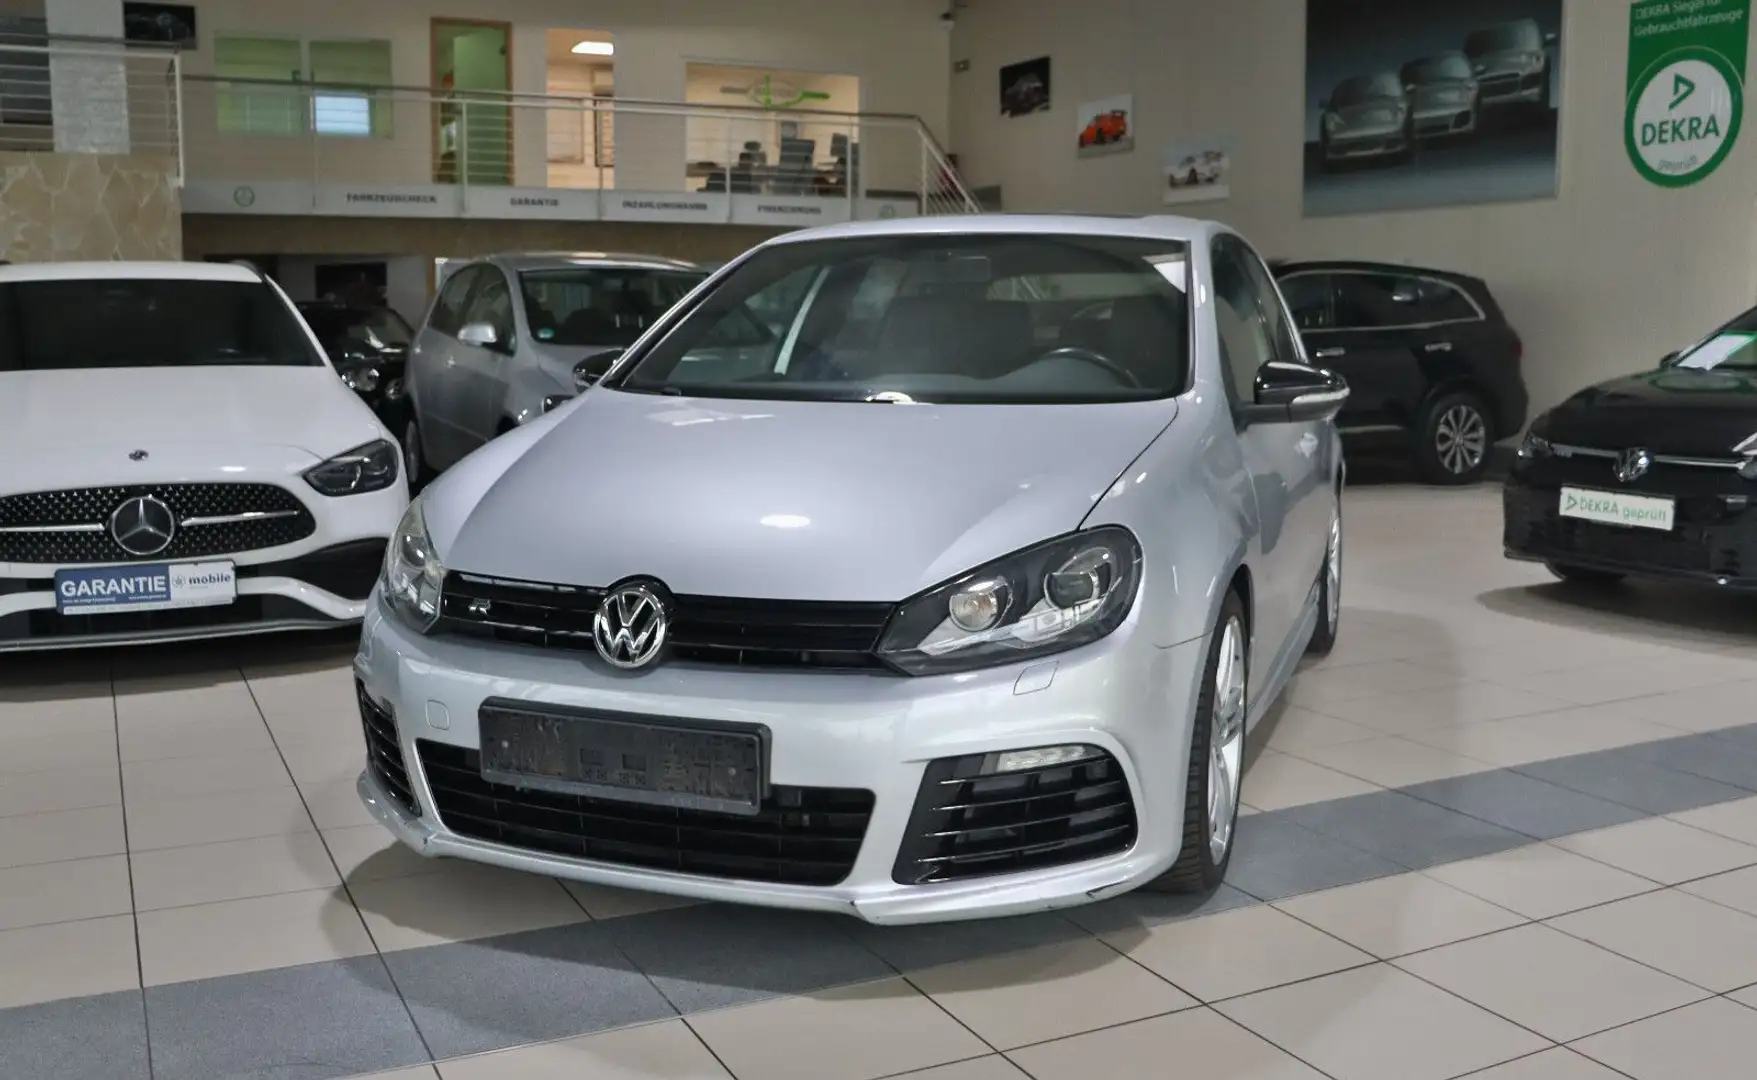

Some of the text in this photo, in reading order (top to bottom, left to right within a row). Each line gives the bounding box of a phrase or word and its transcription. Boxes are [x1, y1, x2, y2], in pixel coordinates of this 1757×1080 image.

[1635, 3, 1671, 19] DEKRA
[1641, 114, 1720, 146] DEKRA
[1580, 496, 1619, 515] DEKRA
[60, 572, 232, 598] GARANTIE mobile
